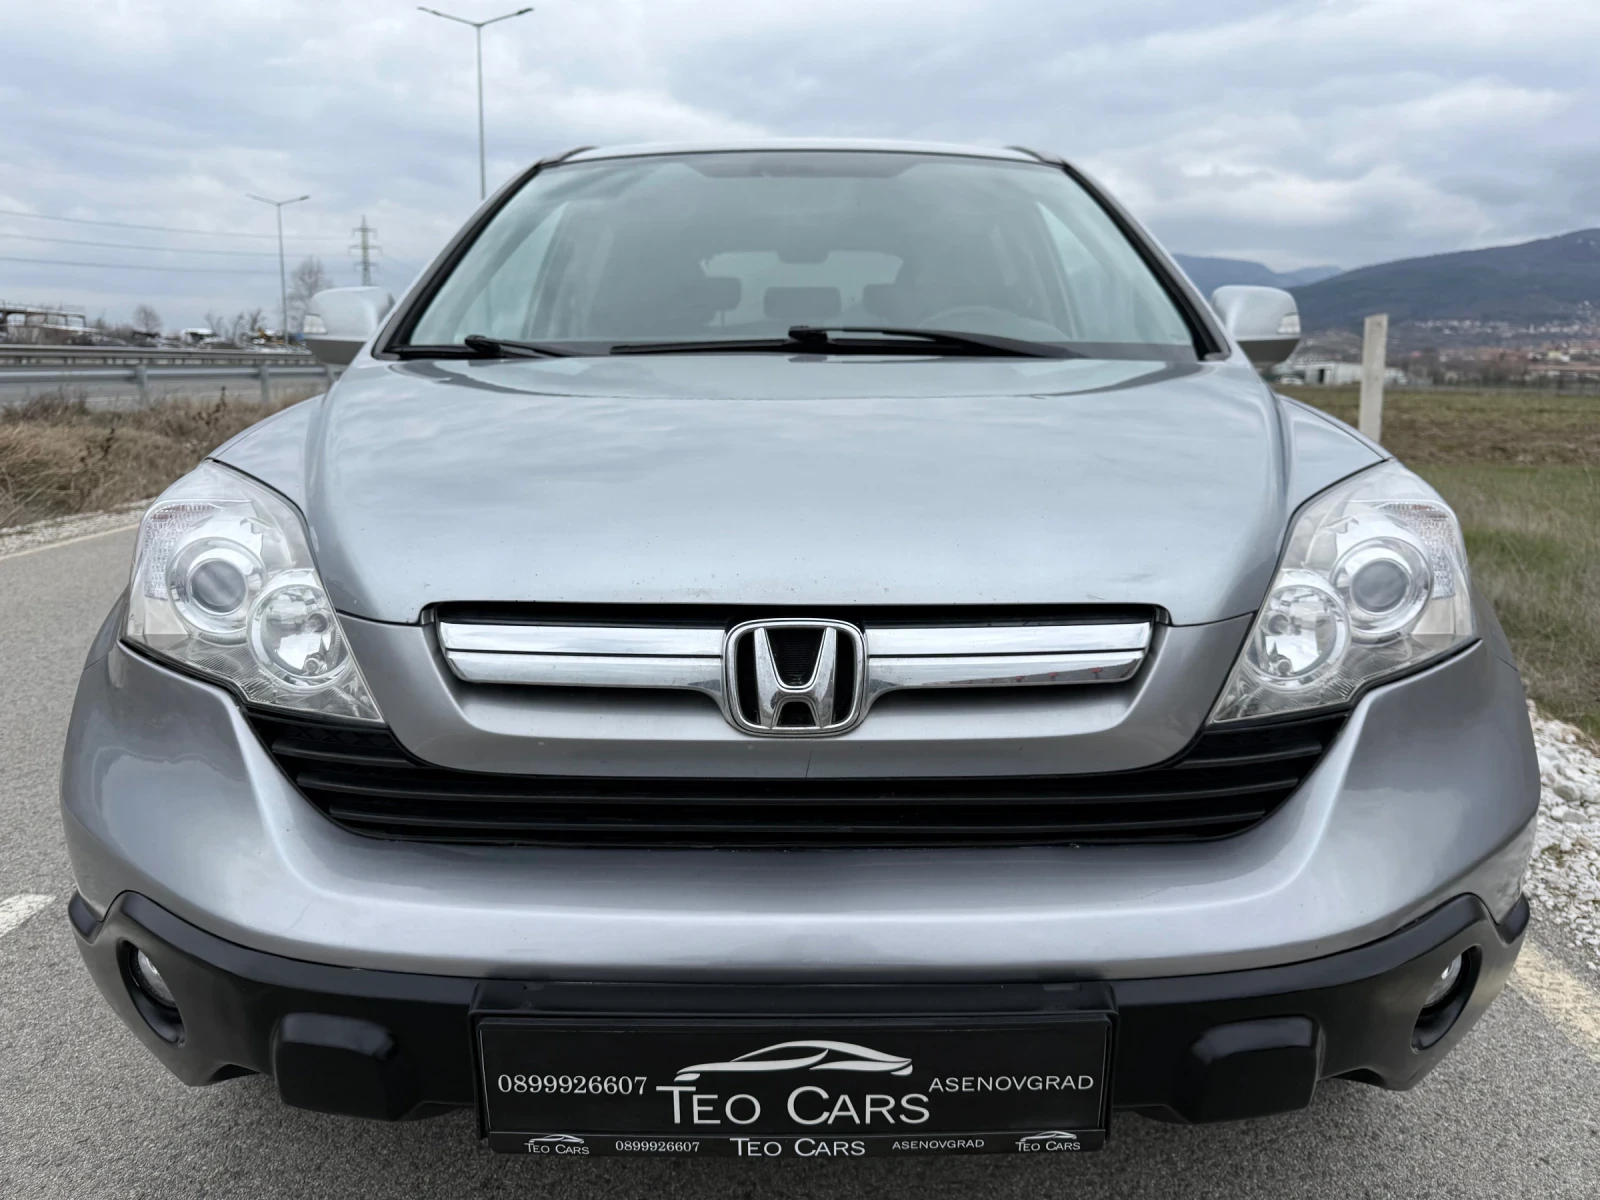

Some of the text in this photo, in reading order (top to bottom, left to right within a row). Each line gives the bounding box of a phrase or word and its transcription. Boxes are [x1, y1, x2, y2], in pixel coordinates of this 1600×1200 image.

[497, 1074, 648, 1096] 0899926607
[928, 1074, 1095, 1093] ASENOVGRAD
[615, 1140, 701, 1152] 0899926607
[891, 1139, 986, 1150] ASENOVGRAD
